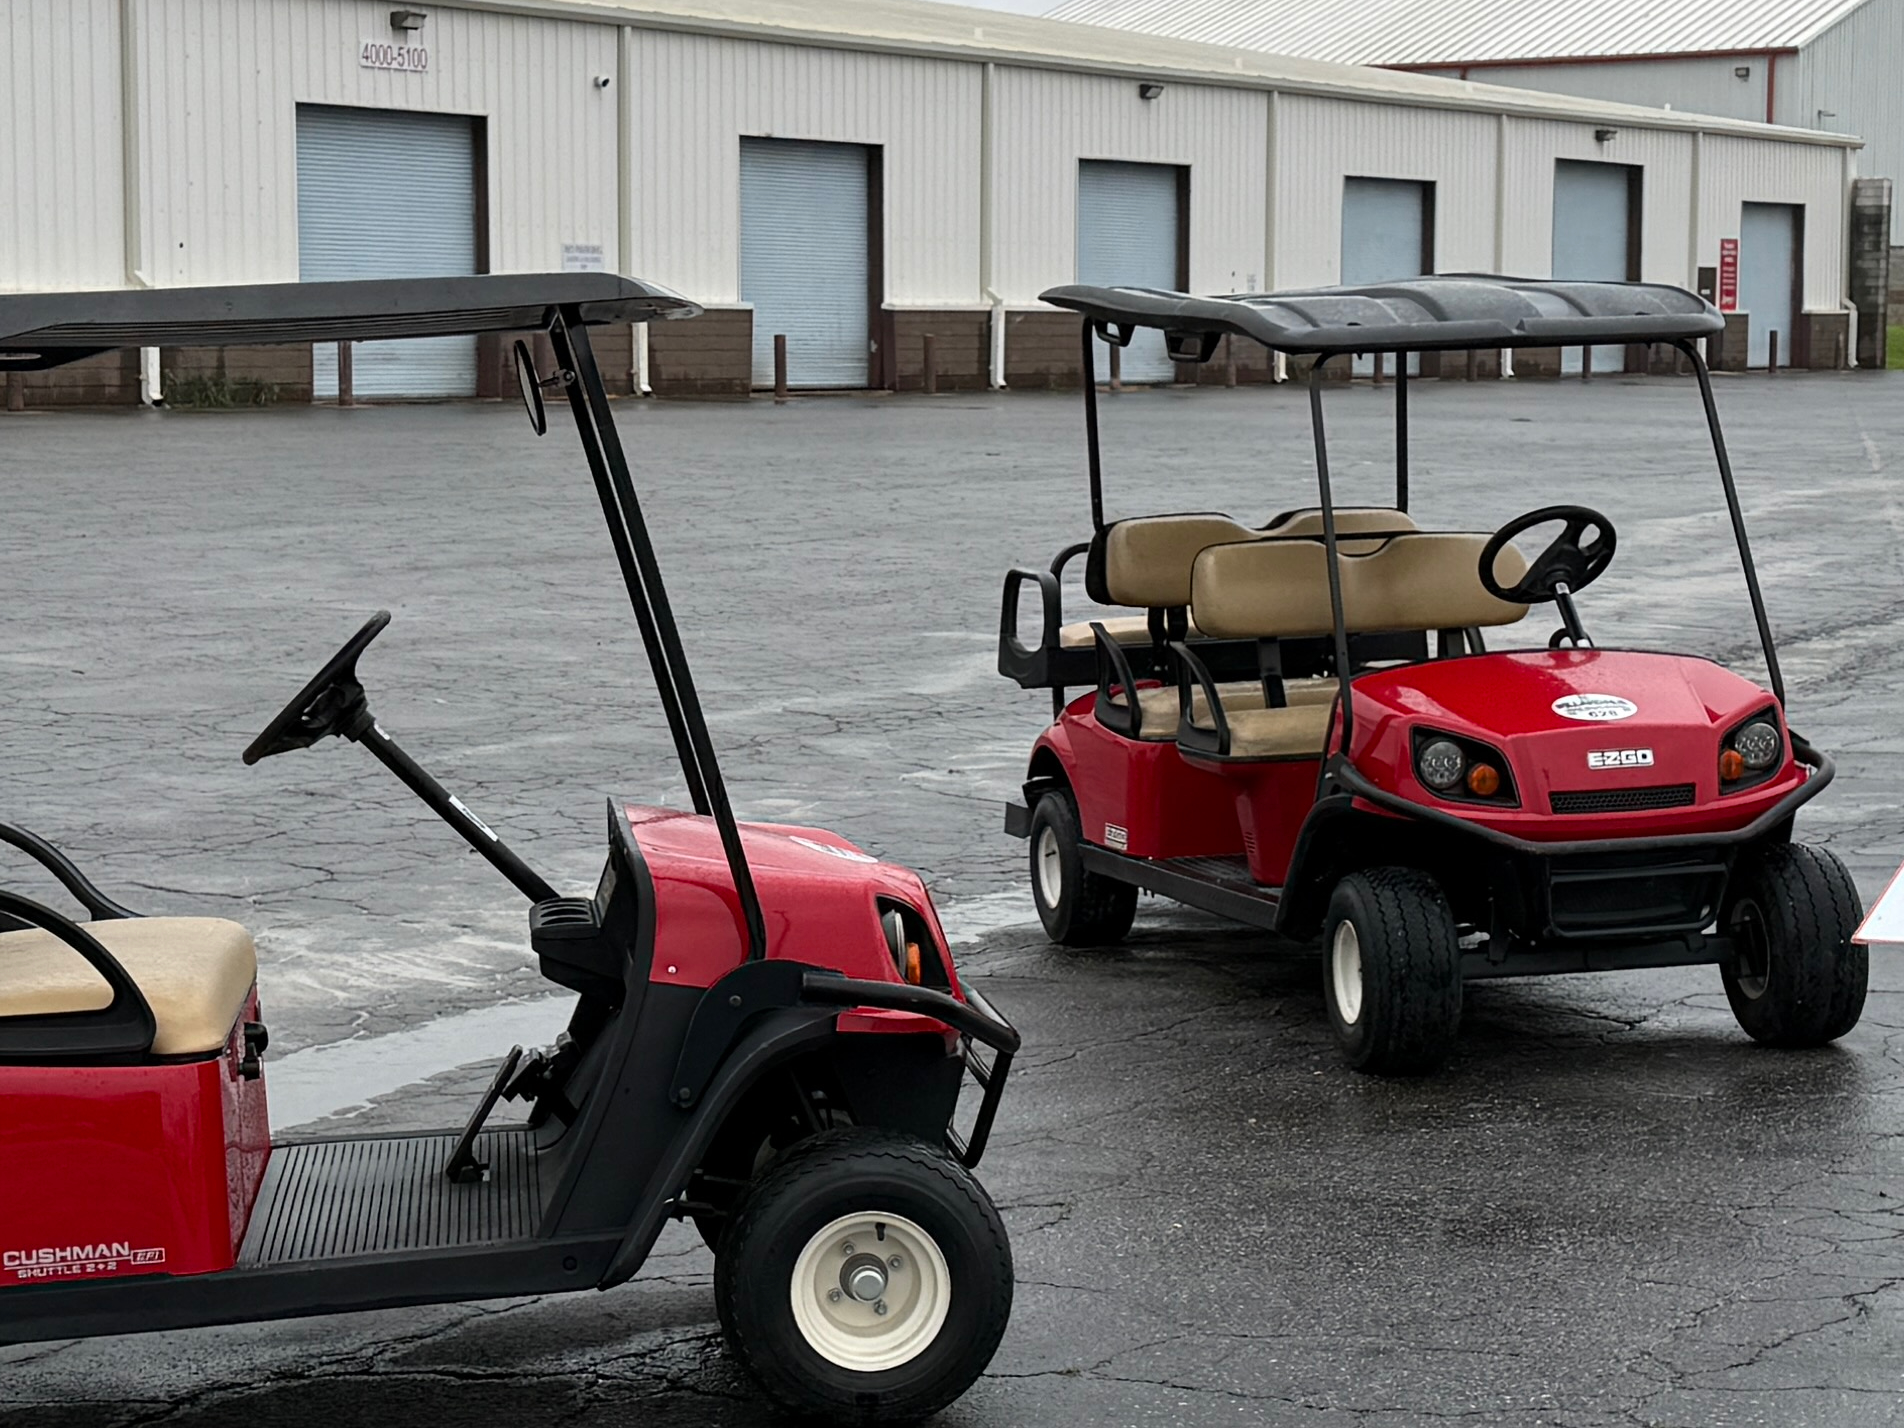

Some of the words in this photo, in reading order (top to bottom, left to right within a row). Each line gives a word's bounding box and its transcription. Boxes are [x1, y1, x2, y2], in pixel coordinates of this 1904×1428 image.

[361, 43, 429, 69] 4000-5100
[3, 1241, 130, 1266] CUSHMAN
[18, 1264, 81, 1278] SHUTTLE
[86, 1261, 118, 1273] 2+2
